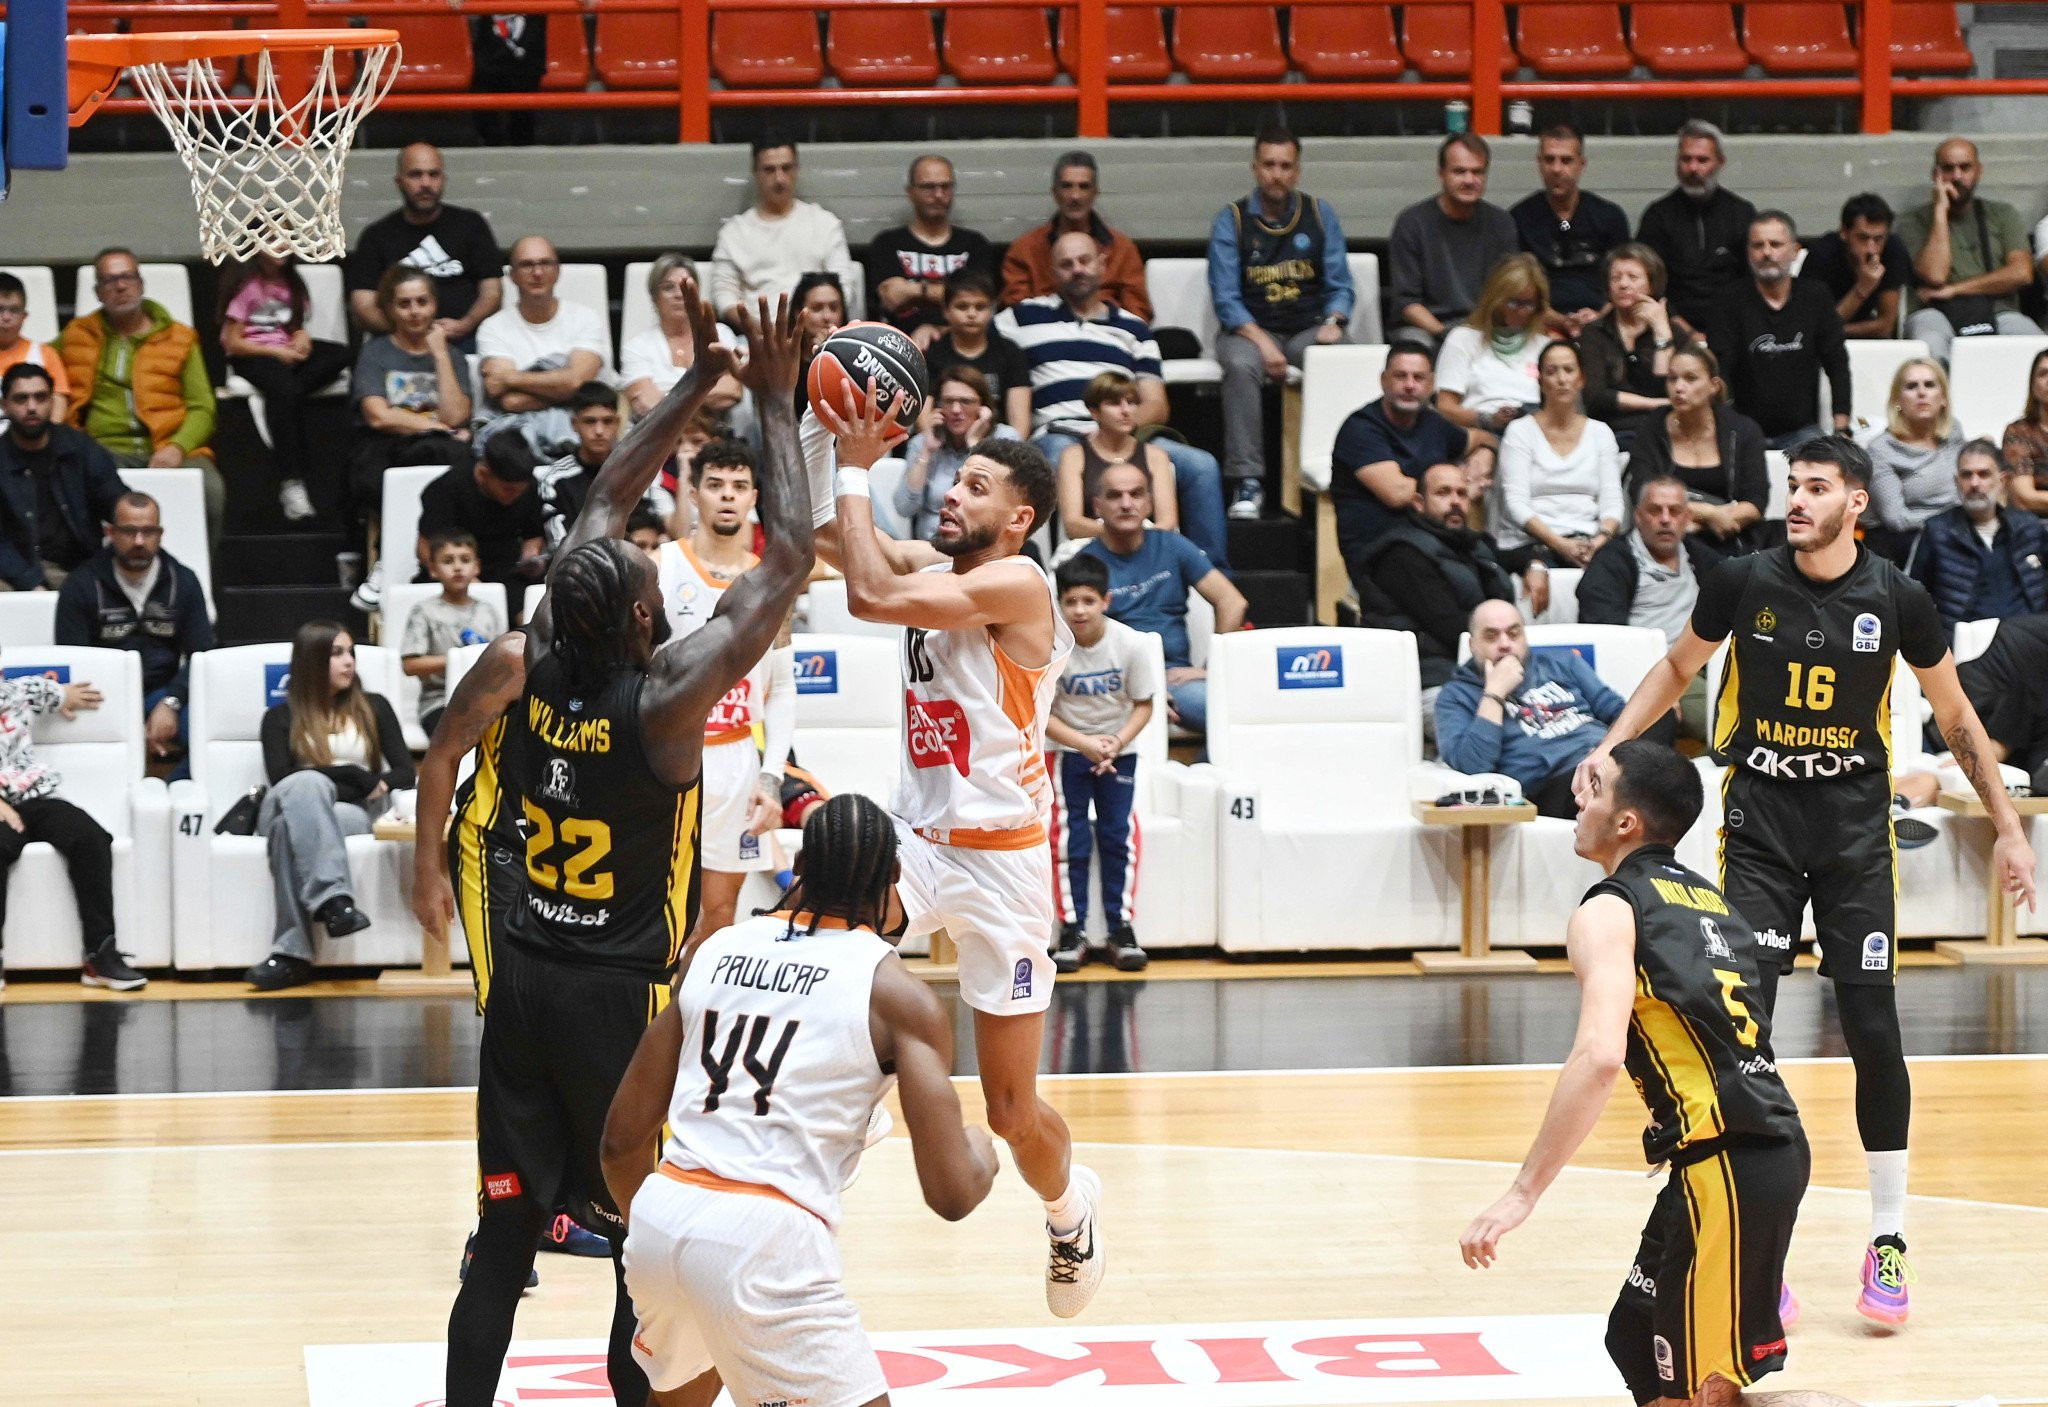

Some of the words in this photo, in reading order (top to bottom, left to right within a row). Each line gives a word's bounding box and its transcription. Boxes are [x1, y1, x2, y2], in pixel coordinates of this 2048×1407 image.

[1856, 641, 1876, 650] GBL
[1061, 668, 1123, 695] VANS
[1784, 661, 1836, 711] 16
[529, 694, 610, 752] WILLIAMS
[1755, 718, 1859, 749] MAROUSSI
[911, 728, 949, 756] COL
[1231, 797, 1254, 819] 43
[179, 814, 203, 836] 47
[522, 794, 615, 900] 22
[710, 954, 830, 996] PAULICAP
[1865, 959, 1886, 968] GBL
[1013, 986, 1030, 998] GBL
[1712, 967, 1759, 1049] 5
[701, 1008, 801, 1116] 44
[490, 1186, 513, 1196] COLA
